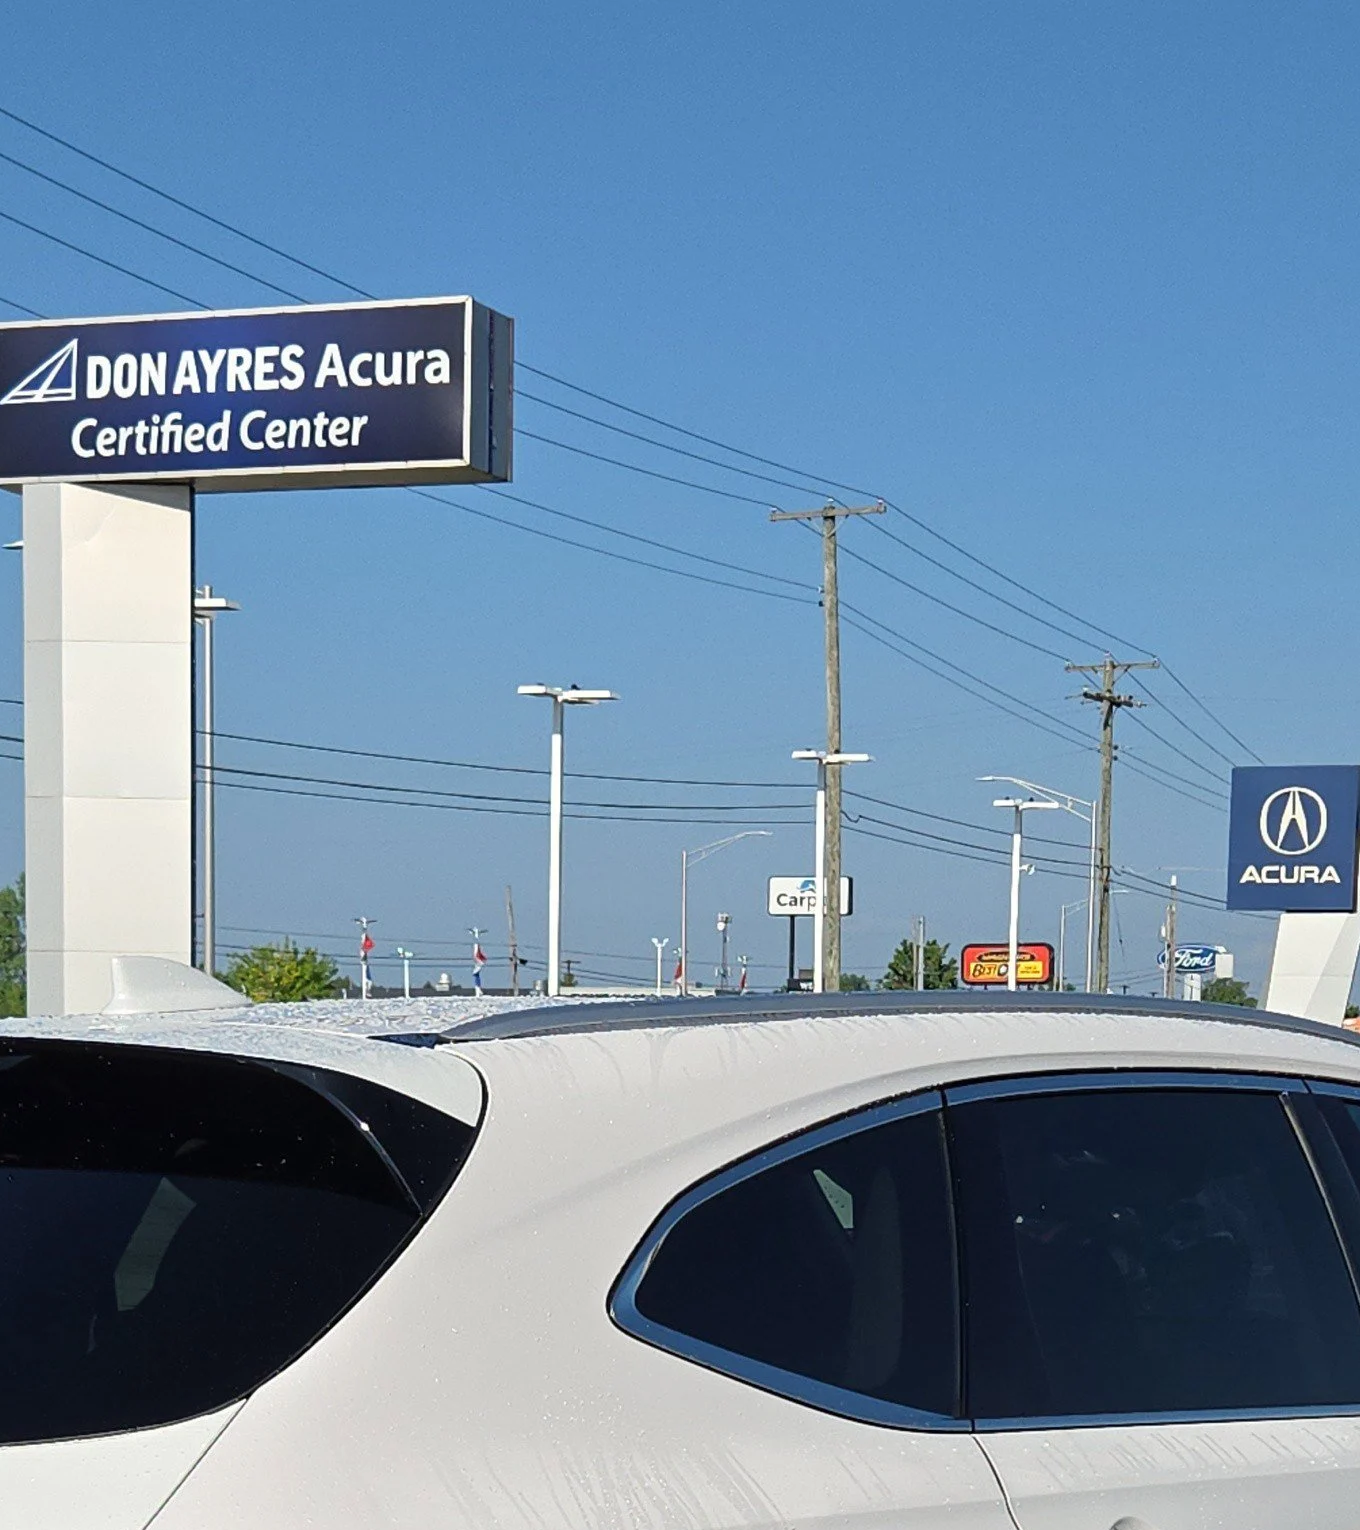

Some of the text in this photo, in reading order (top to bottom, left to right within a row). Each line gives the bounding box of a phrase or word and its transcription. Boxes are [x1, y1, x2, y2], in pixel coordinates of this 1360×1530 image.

[86, 342, 451, 400] DON AYRES Acura
[71, 409, 369, 459] Certified Center
[1239, 865, 1341, 884] ACURA
[1174, 948, 1215, 968] Ford
